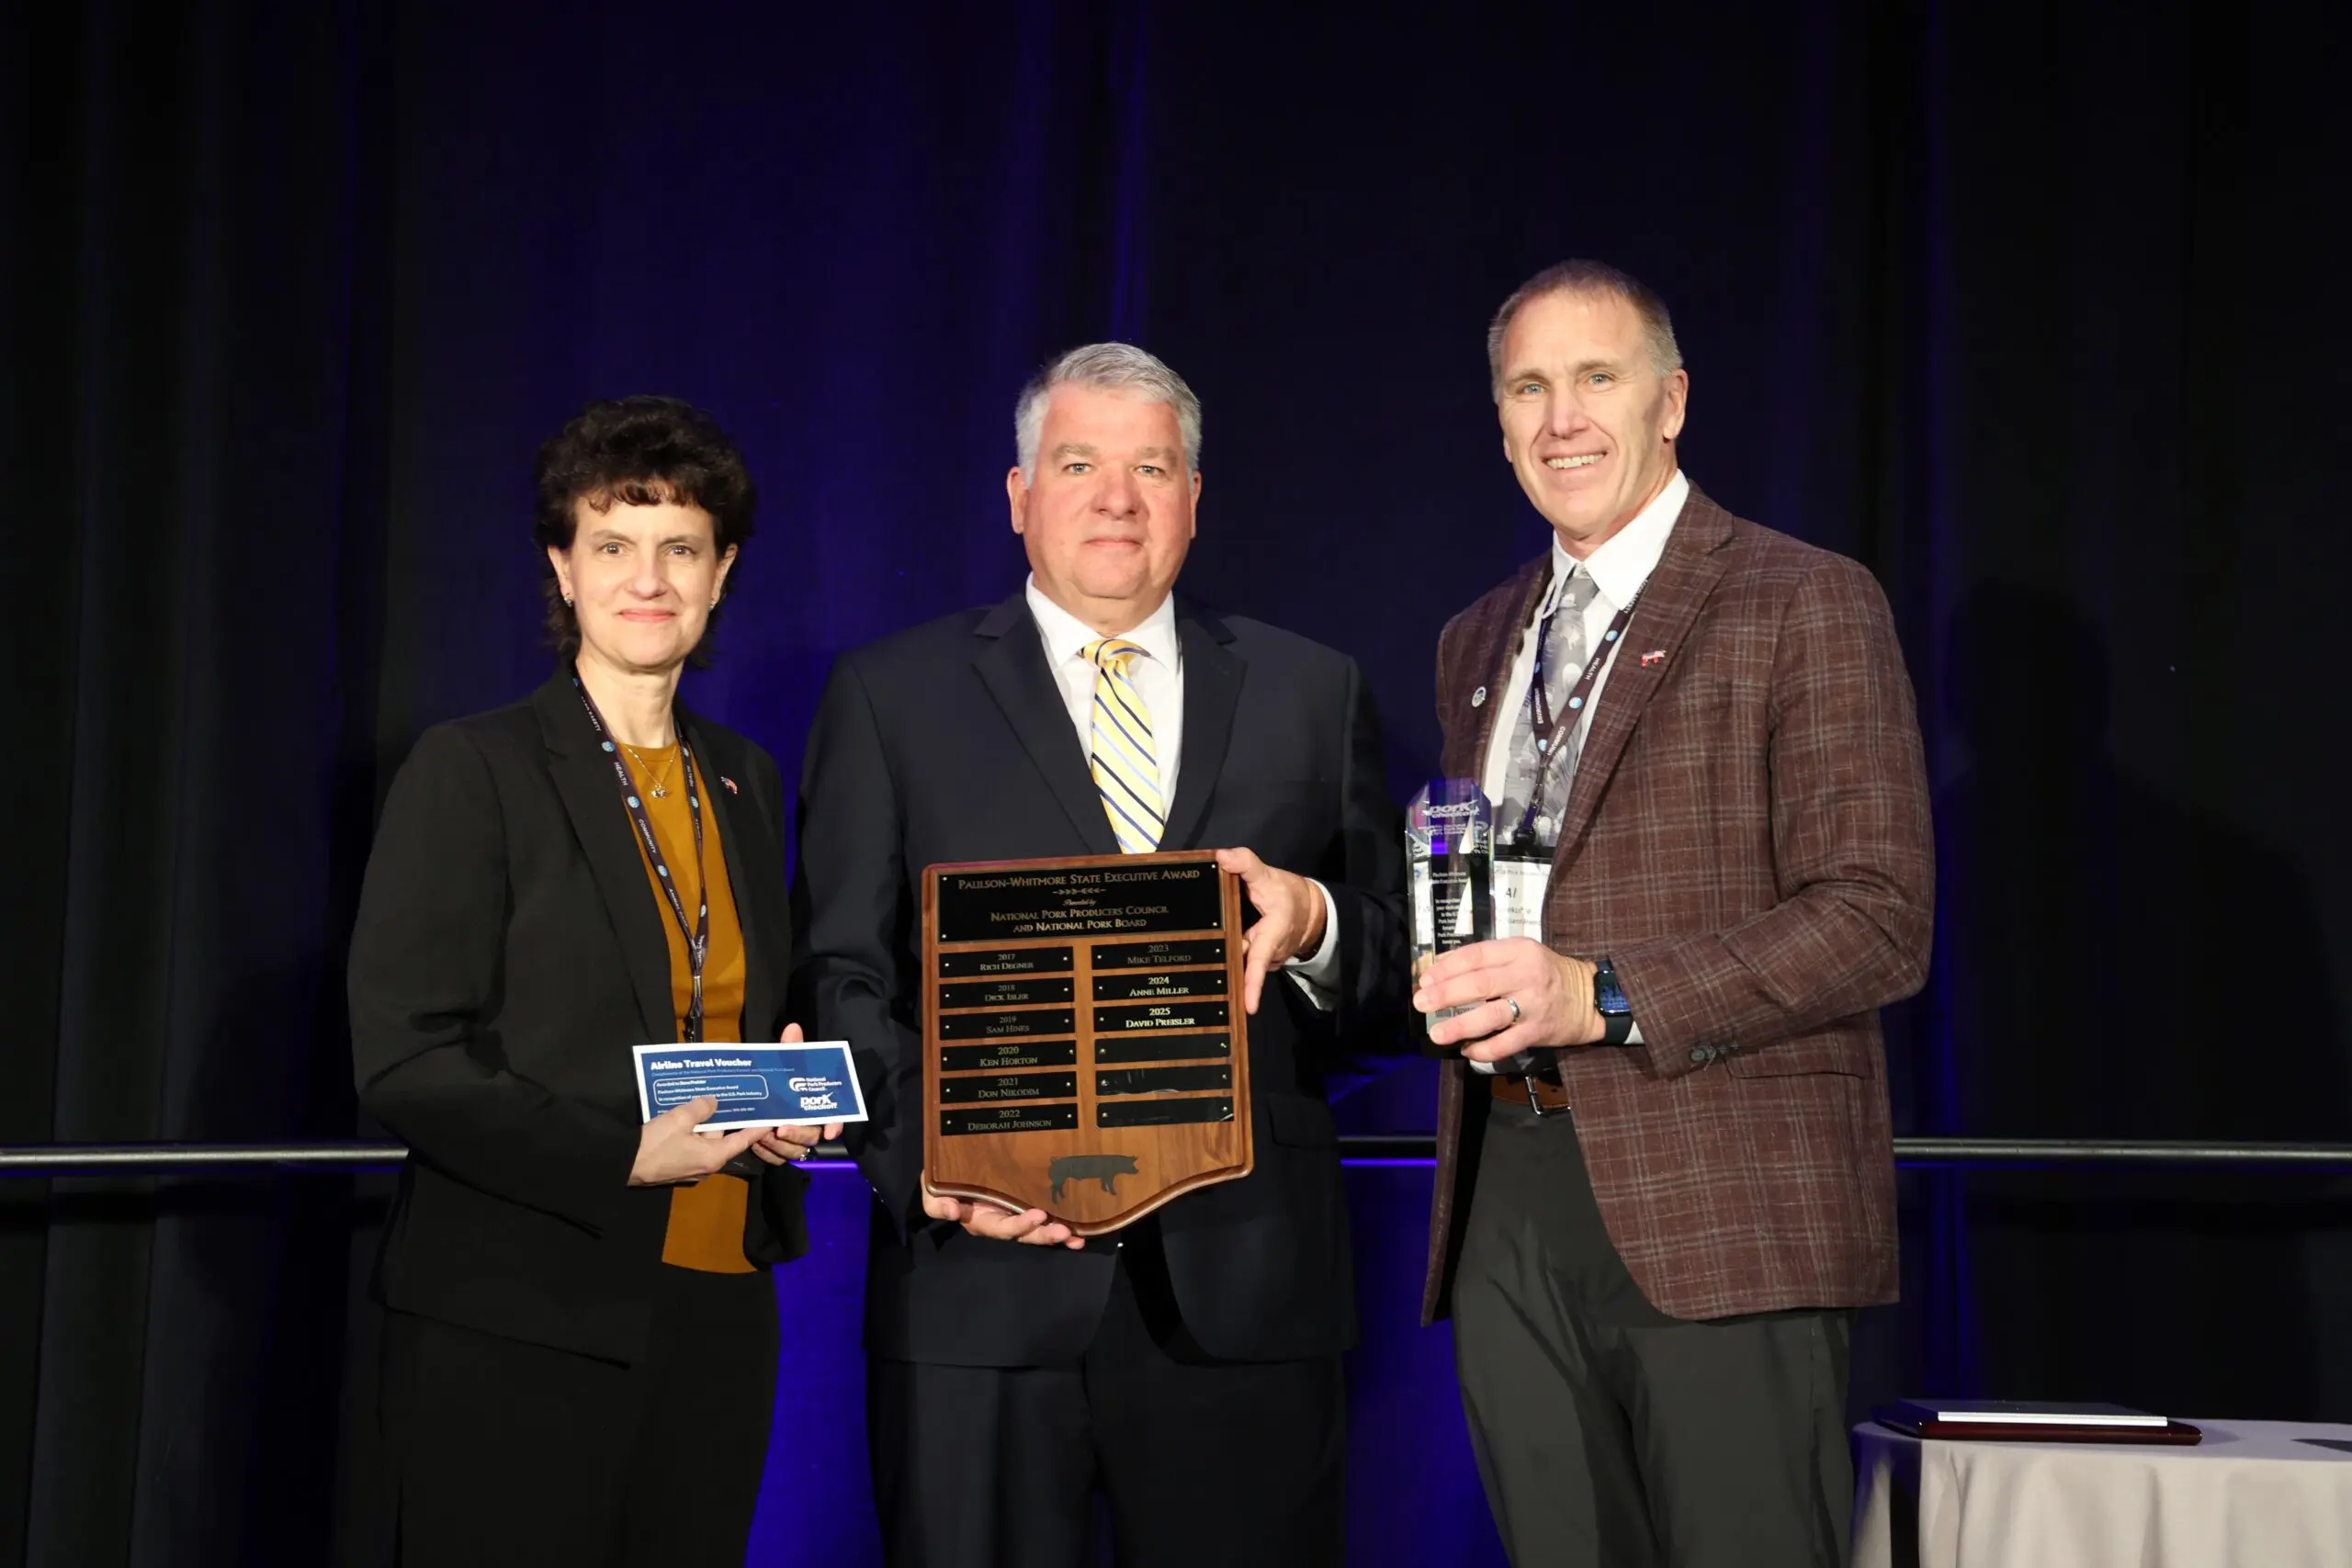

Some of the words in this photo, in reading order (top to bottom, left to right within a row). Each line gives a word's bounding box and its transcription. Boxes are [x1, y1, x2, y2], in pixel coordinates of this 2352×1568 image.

[1585, 658, 1600, 680] HEALTH
[614, 761, 628, 785] HEALTH
[639, 818, 657, 854] COMMUNITY
[958, 876, 1067, 889] PAULSON-WHITMORE
[1069, 874, 1102, 884] STATE
[1104, 872, 1159, 882] EXECUTIVE
[1161, 870, 1201, 880] AWARD
[990, 911, 1039, 921] NATIONAL
[1042, 909, 1067, 919] PORK
[1069, 908, 1124, 918] PRODUCERS
[1125, 906, 1170, 915] COUNCIL
[1012, 924, 1034, 933] AND
[1035, 921, 1084, 931] NATIONAL
[1087, 919, 1113, 930] PORK
[1114, 919, 1148, 928] BOARD
[1148, 944, 1169, 953] 2023
[1127, 956, 1151, 964] MIKE
[1153, 954, 1192, 964] TELFORD
[979, 963, 1000, 971] RICH
[1148, 976, 1170, 985] 2024
[1129, 988, 1155, 997] ANNE
[1156, 987, 1189, 995] MILLER
[1148, 1007, 1170, 1016] 2025
[1125, 1019, 1154, 1028] DAVID
[1155, 1018, 1195, 1026] PREISLER
[986, 1026, 1004, 1034] SAM
[998, 1046, 1020, 1055] 2020
[650, 1061, 684, 1070] Airline
[684, 1059, 714, 1068] Travel
[715, 1058, 752, 1067] Voucher
[979, 1058, 1000, 1066] KEN
[1001, 1056, 1038, 1066] HORTON
[998, 1077, 1018, 1086] 2021
[978, 1089, 998, 1099] DON
[1001, 1089, 1039, 1097] NIKODIM
[800, 1092, 833, 1108] pork
[999, 1110, 1021, 1118] 2022
[967, 1122, 1011, 1131] DEBORAH
[1012, 1120, 1052, 1129] JOHNSON
